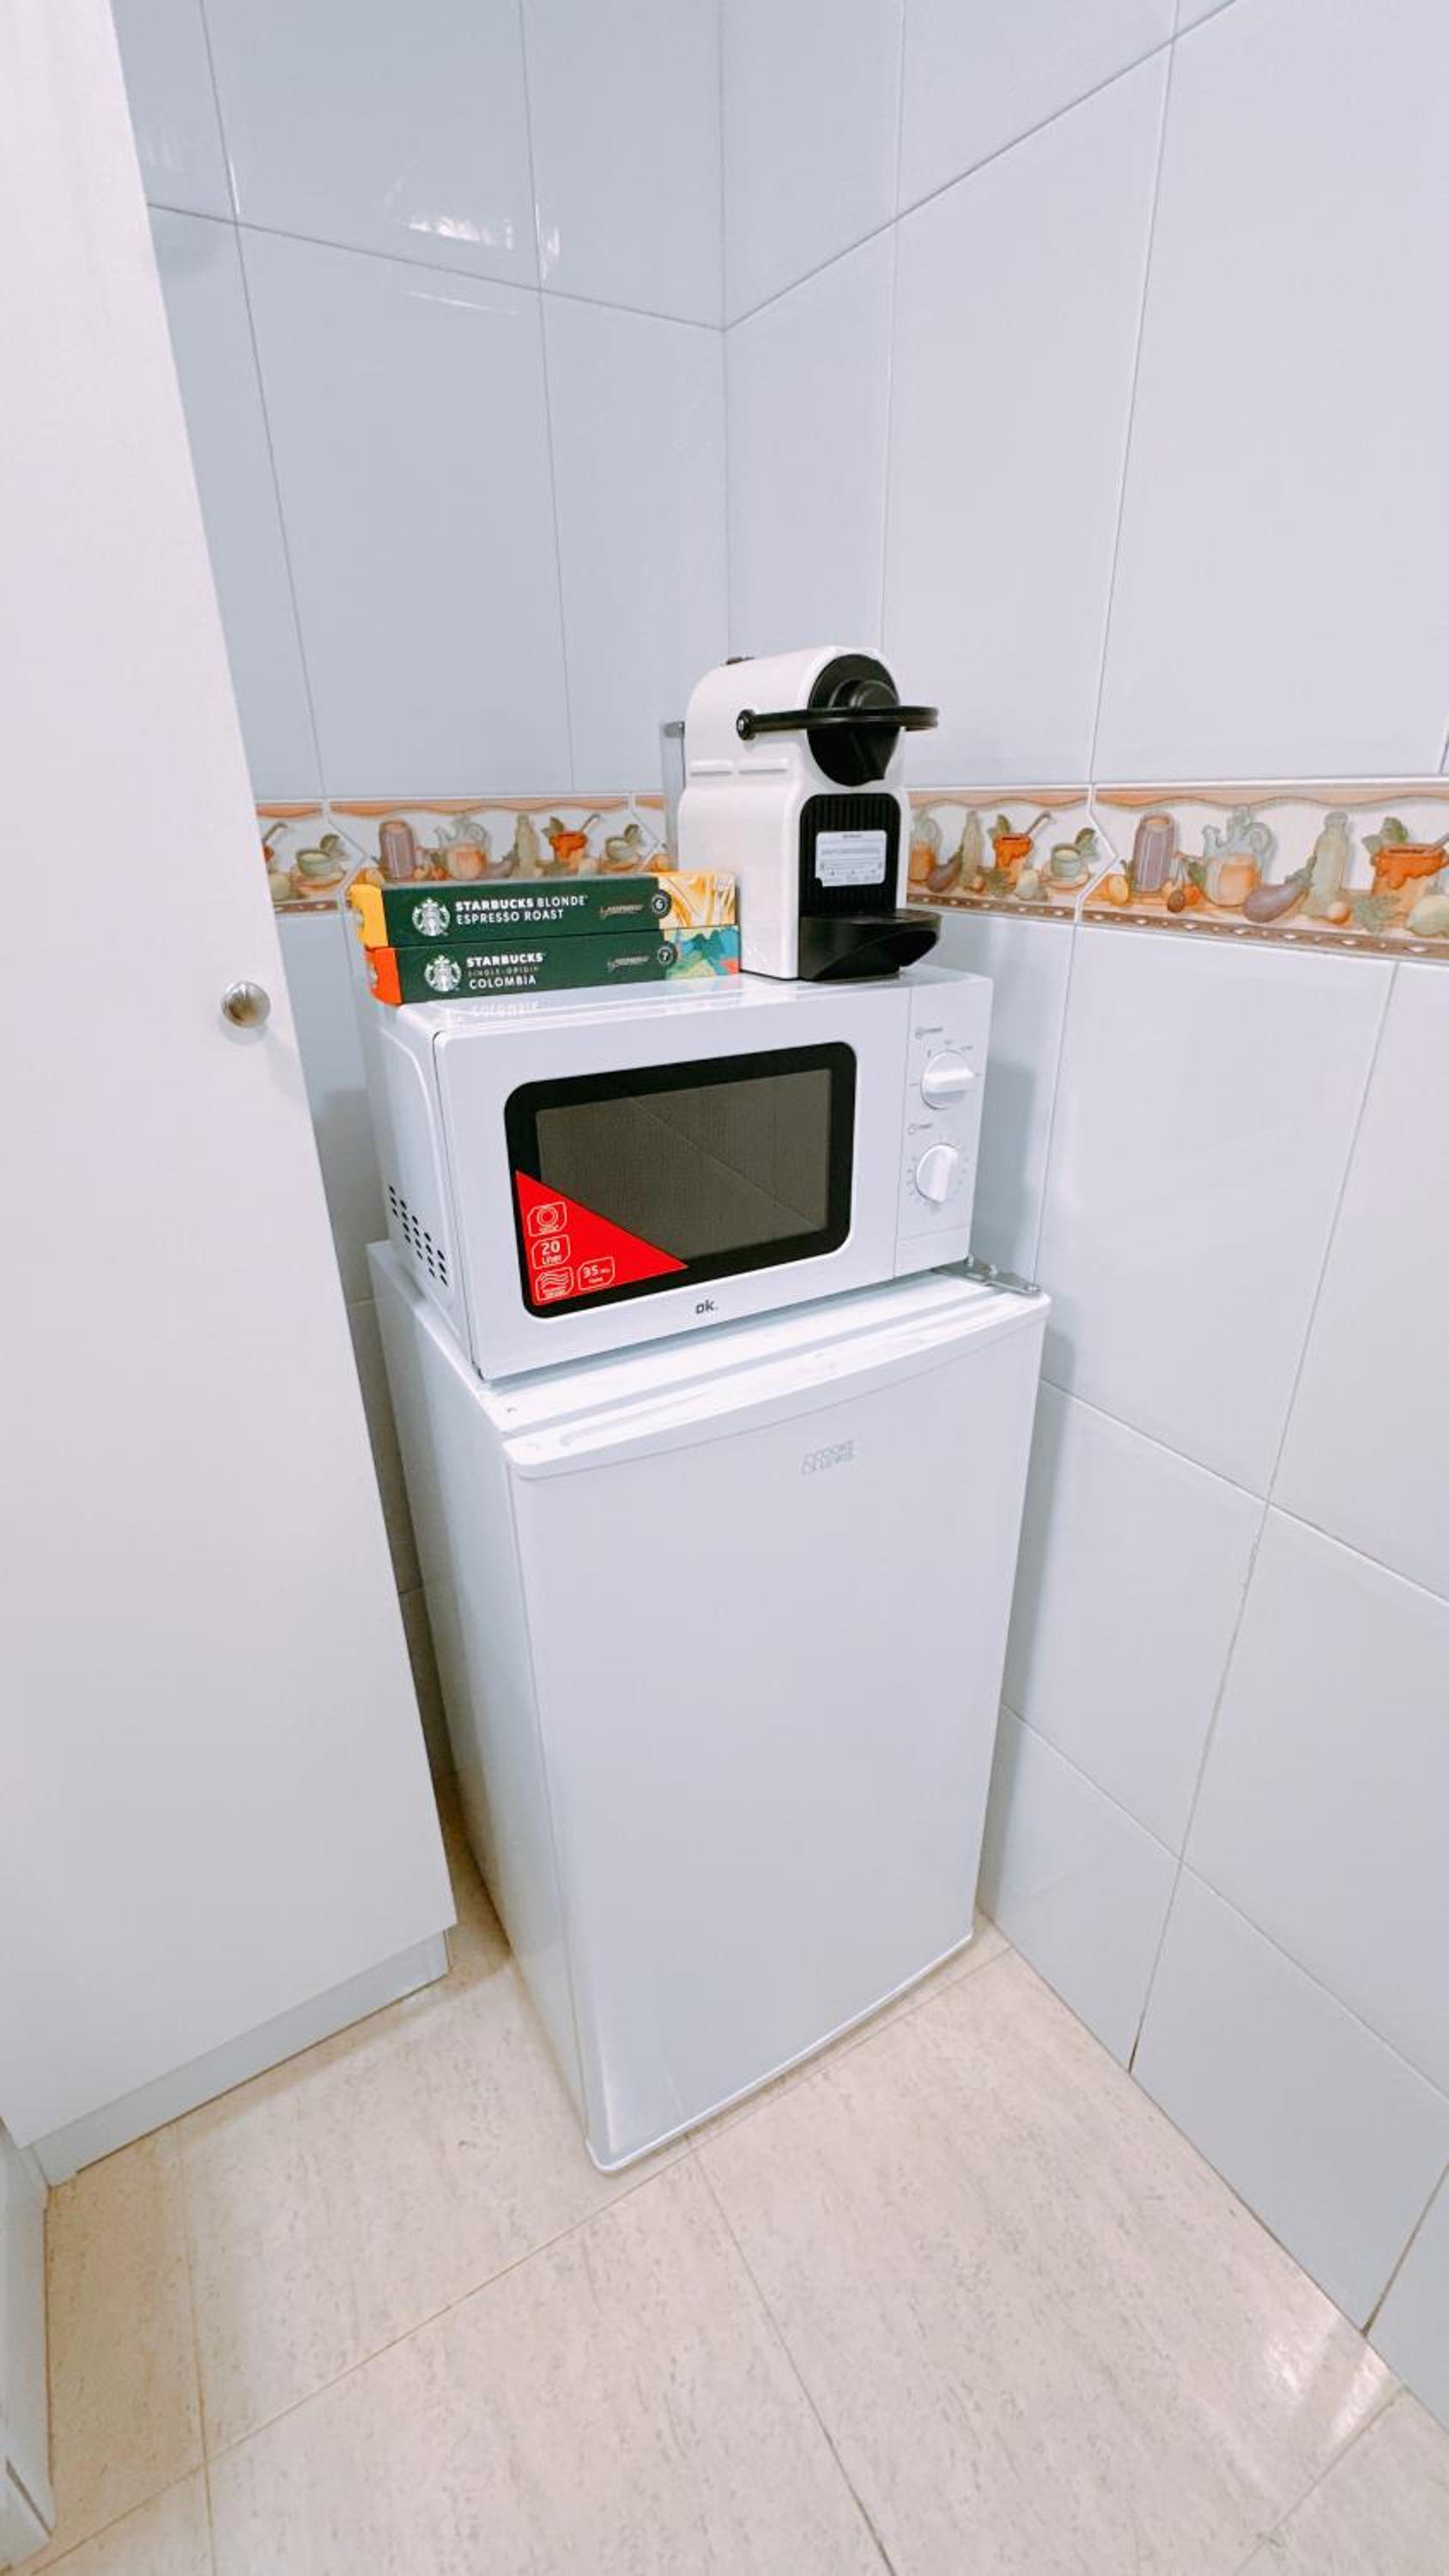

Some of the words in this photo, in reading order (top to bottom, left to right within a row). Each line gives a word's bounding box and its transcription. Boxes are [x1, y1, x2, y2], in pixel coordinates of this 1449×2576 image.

[455, 897, 534, 912] STARBUCKS
[537, 896, 585, 908] BLONDE
[655, 898, 664, 910] 6
[456, 912, 519, 926] ESPRESSO
[524, 908, 564, 921] ROAST
[466, 952, 543, 968] STARBUCKS
[661, 951, 670, 963] 7
[470, 975, 537, 990] COLOMBIA
[541, 1240, 561, 1256] 20
